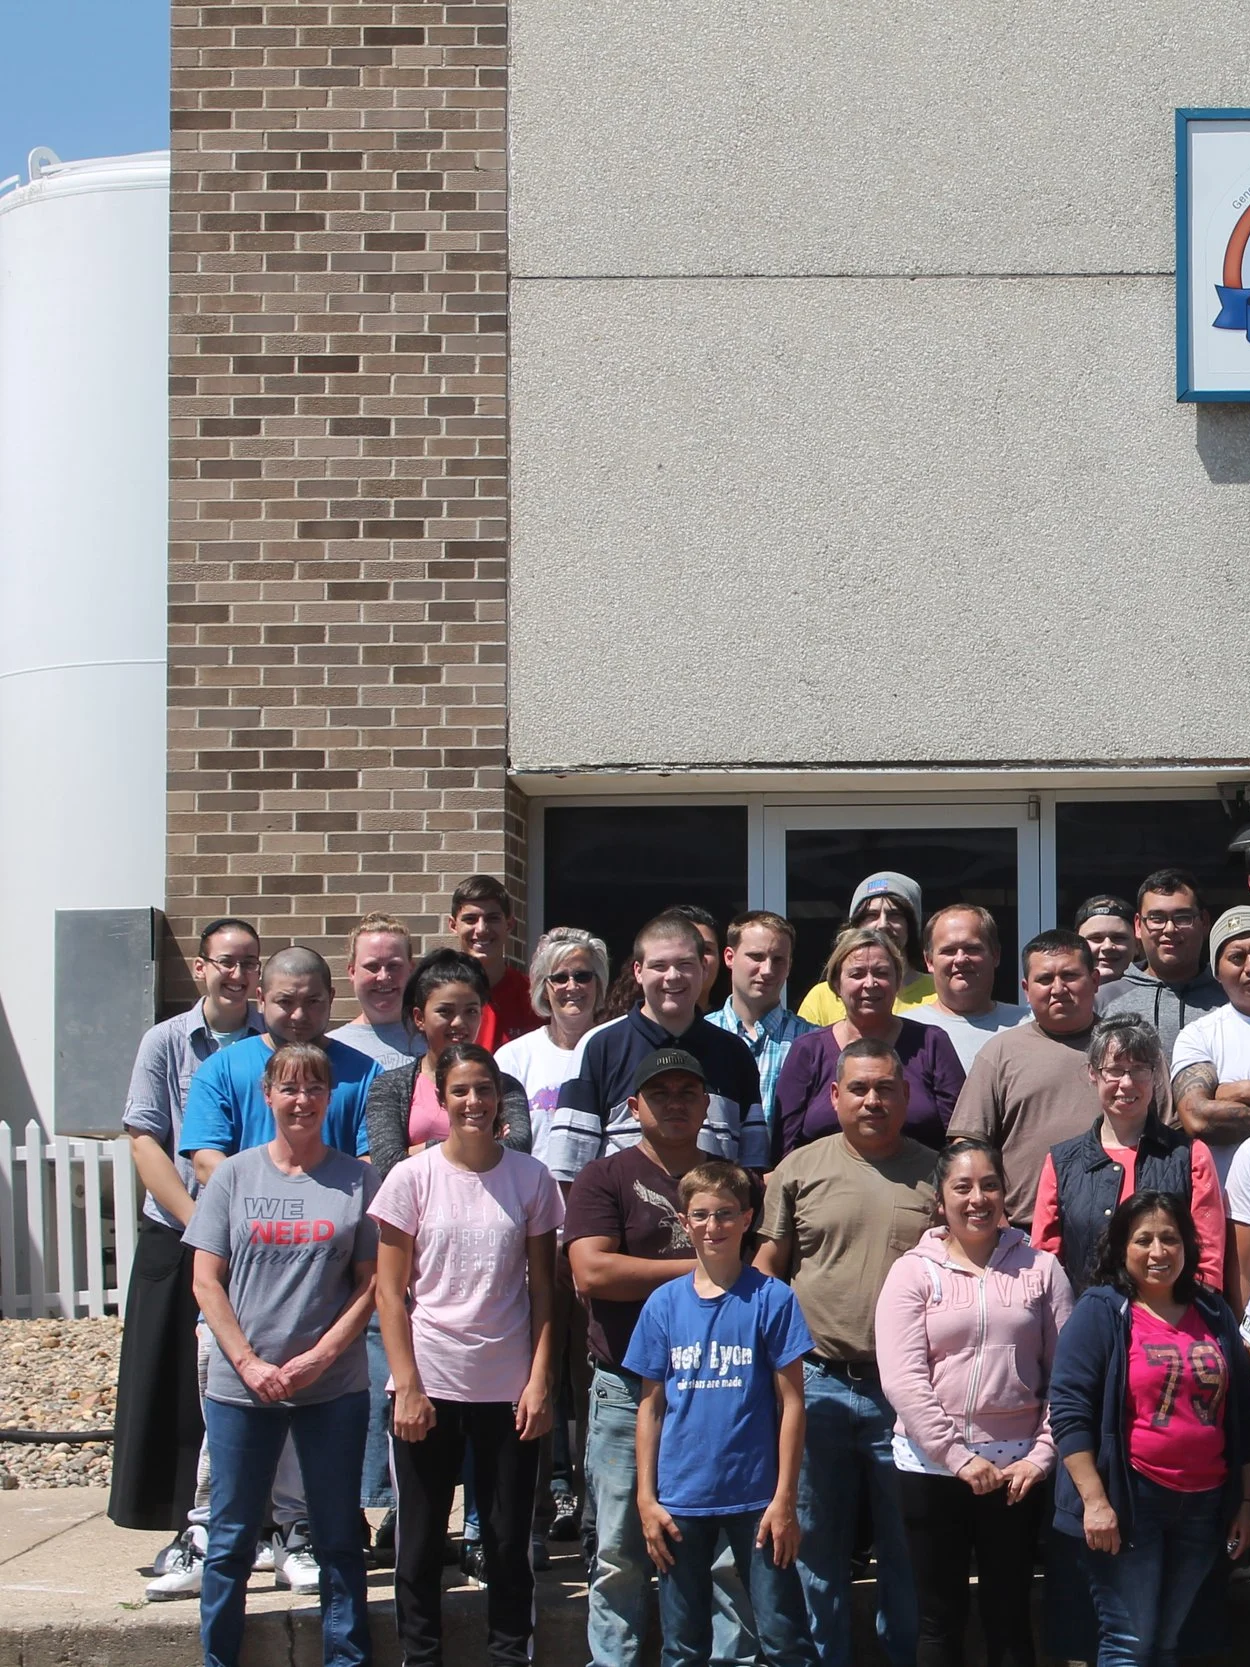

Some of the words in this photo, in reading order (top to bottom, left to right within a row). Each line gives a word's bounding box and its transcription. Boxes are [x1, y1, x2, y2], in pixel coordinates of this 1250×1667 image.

[244, 1197, 305, 1219] WE
[251, 1219, 335, 1245] NEED
[710, 1340, 752, 1377] Lyon
[721, 1375, 742, 1388] made
[1142, 1340, 1226, 1427] 79
